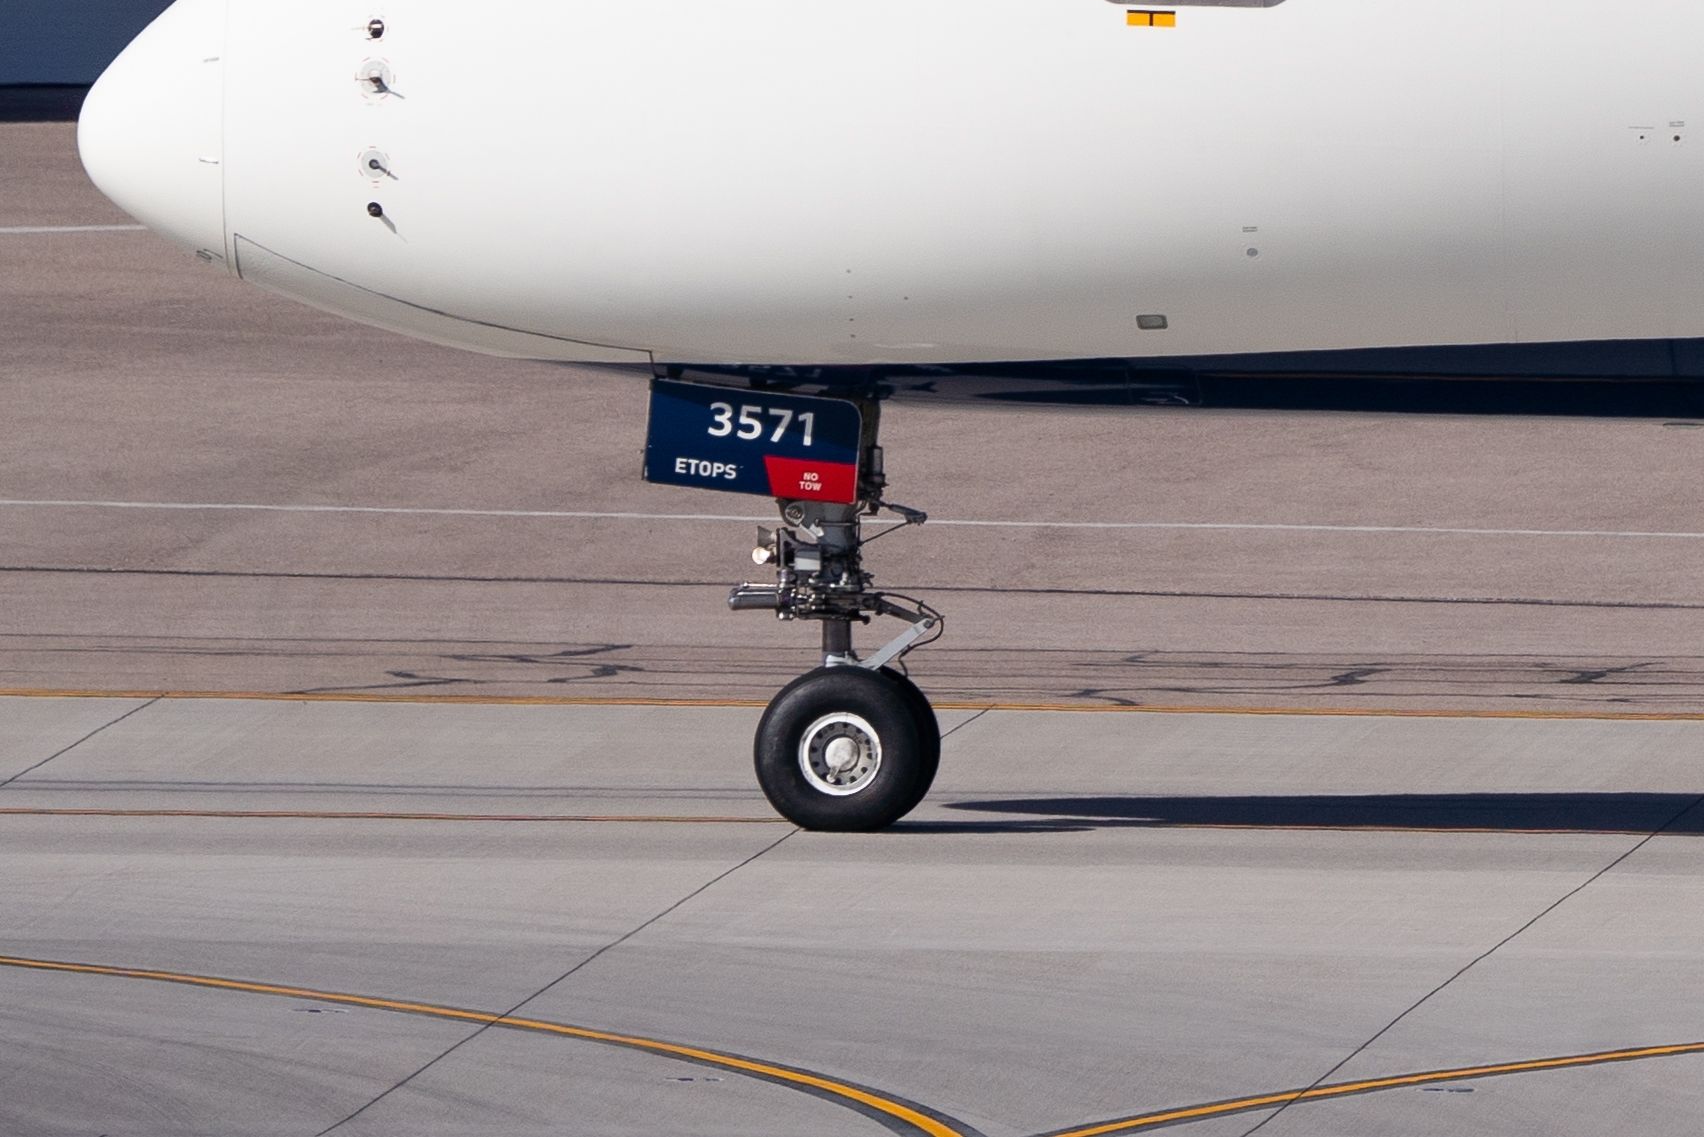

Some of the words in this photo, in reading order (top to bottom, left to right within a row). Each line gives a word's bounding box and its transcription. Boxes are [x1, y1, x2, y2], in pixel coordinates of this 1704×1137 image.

[707, 402, 815, 446] 3571
[674, 457, 737, 480] ETOPS
[803, 472, 819, 481] NO
[799, 481, 822, 492] TOW
